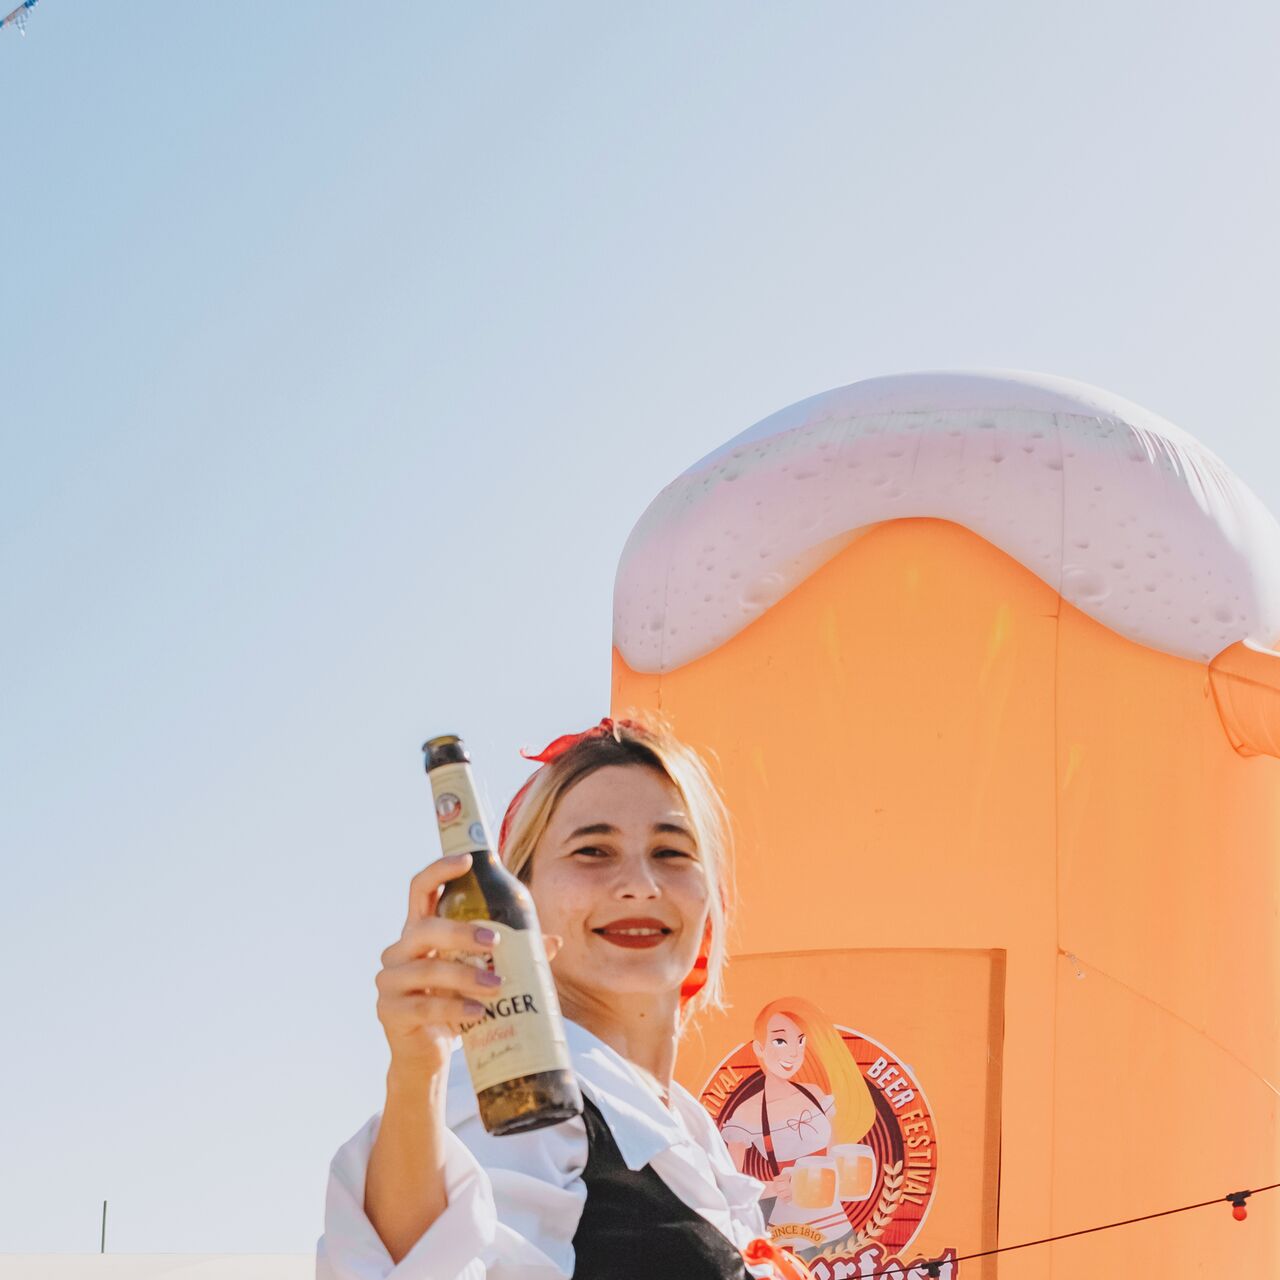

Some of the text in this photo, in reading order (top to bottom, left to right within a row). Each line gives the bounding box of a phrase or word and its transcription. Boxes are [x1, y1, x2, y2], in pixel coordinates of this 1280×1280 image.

[867, 1056, 933, 1206] BEER FESTIVAL
[800, 1227, 822, 1242] 1810
